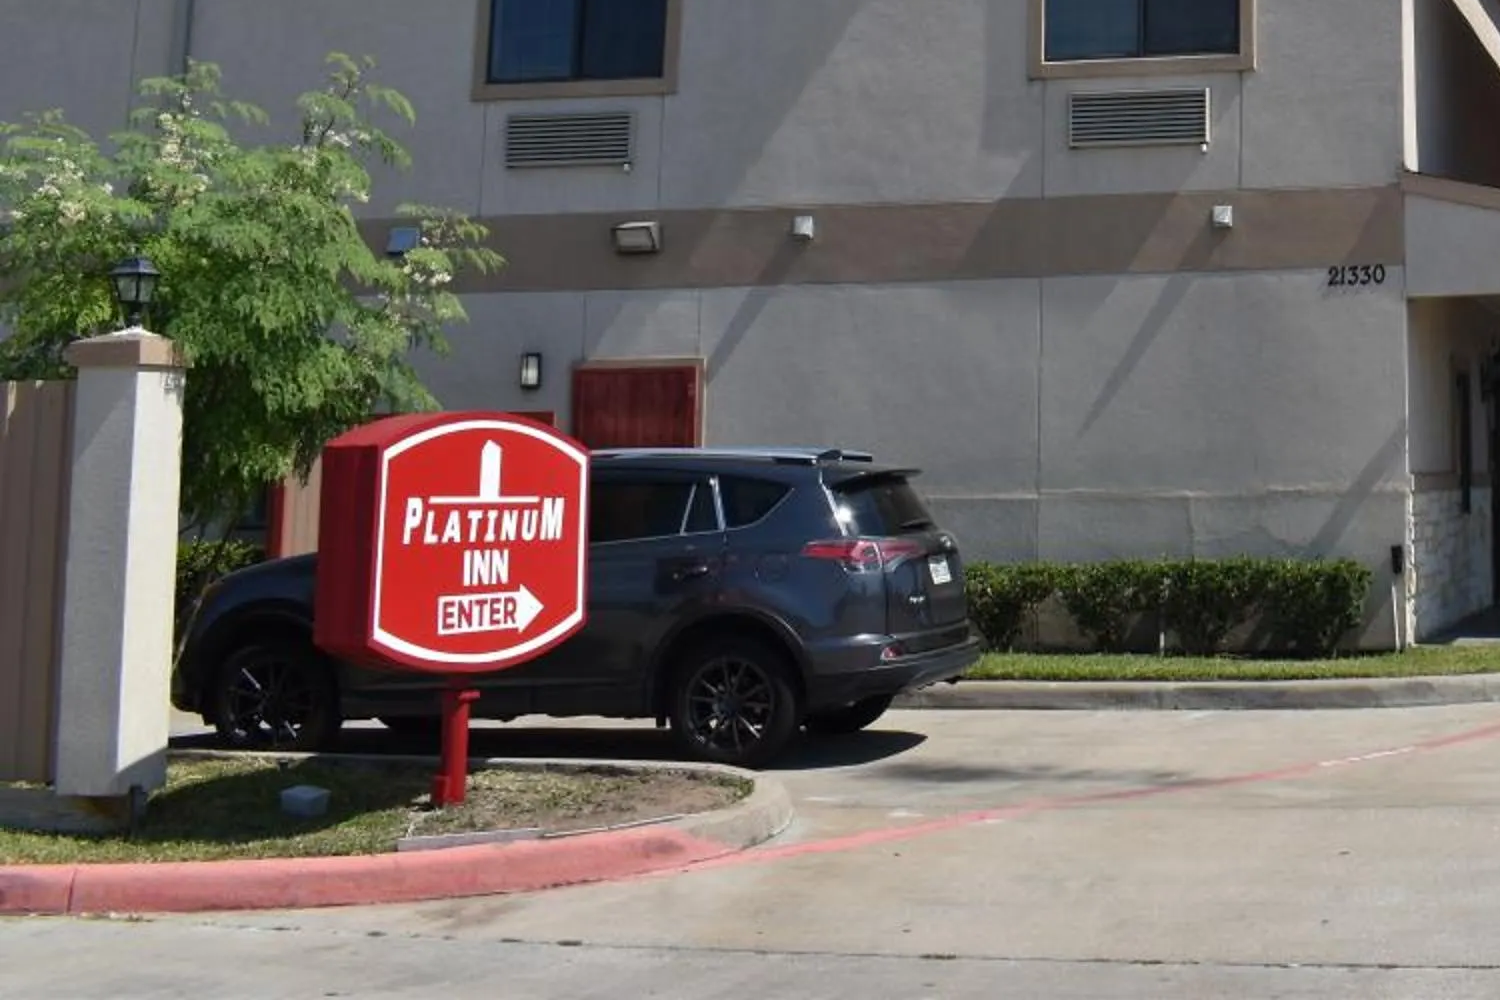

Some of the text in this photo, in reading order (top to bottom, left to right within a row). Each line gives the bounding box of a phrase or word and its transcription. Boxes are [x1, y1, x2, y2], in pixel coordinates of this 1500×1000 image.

[1327, 263, 1386, 287] 21330
[402, 497, 565, 545] PLATINUM
[463, 549, 509, 587] INN
[441, 597, 517, 631] ENTER
